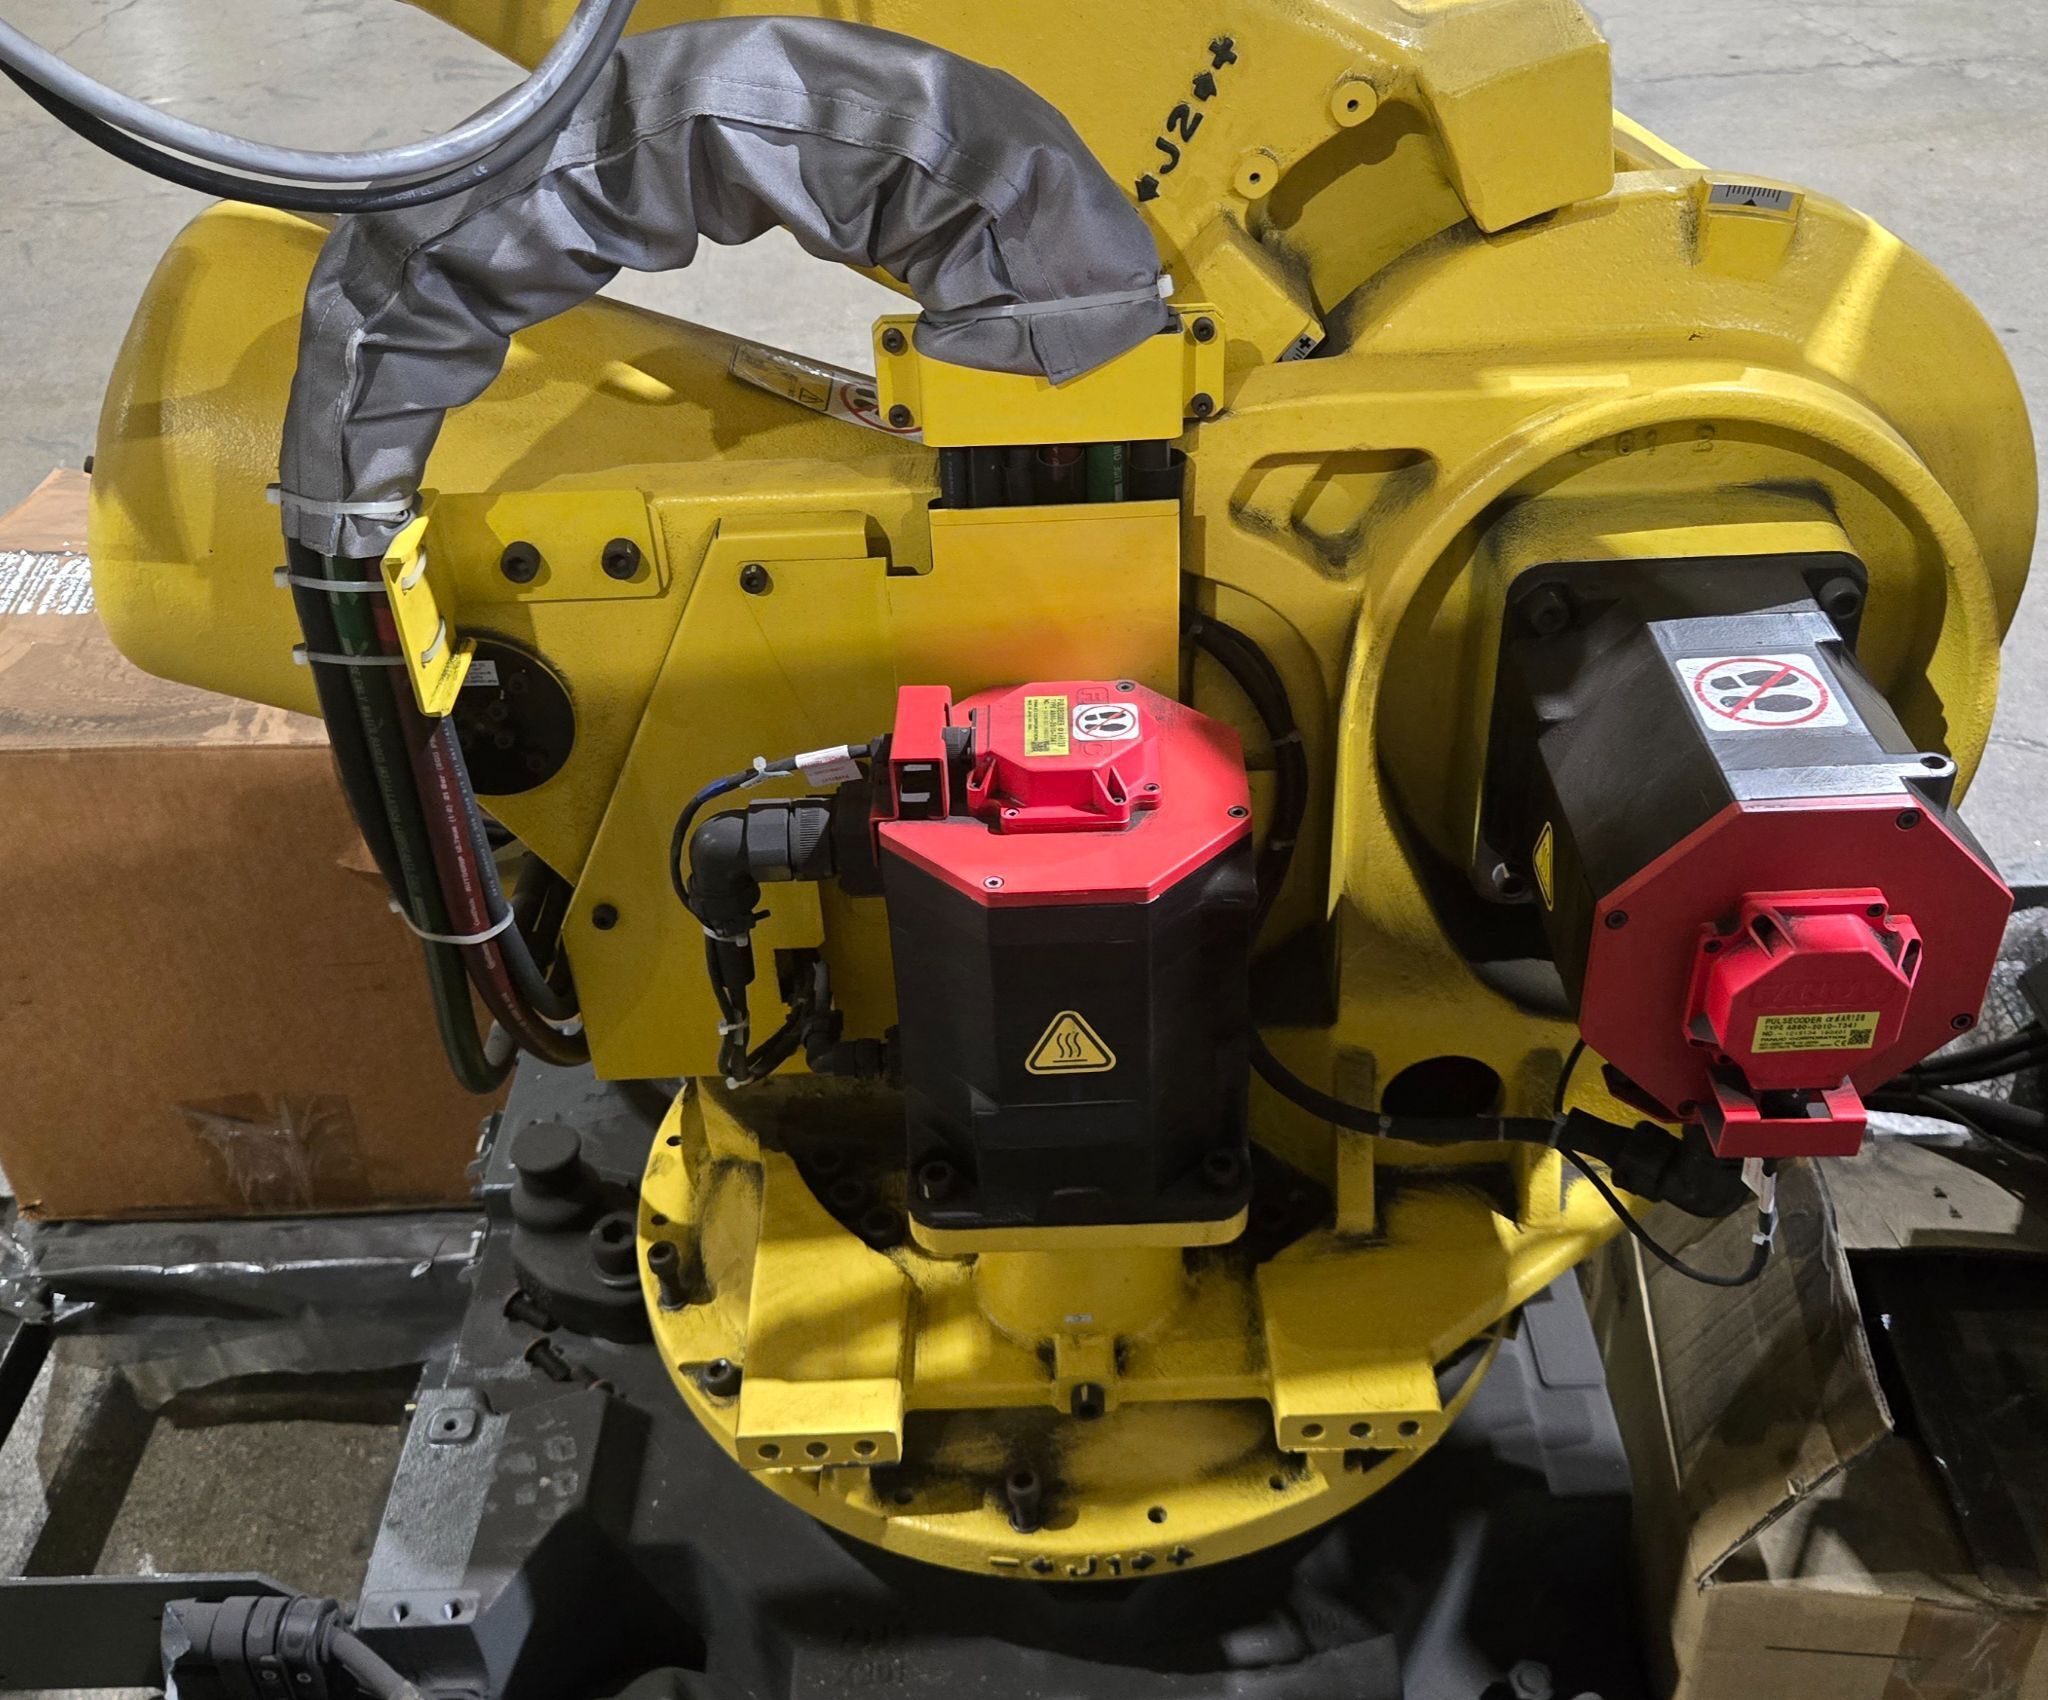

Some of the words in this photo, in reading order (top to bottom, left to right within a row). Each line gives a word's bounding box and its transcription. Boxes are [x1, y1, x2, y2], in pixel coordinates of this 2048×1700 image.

[1155, 103, 1204, 174] J2
[1765, 1016, 1822, 1025] PULSECODER
[1066, 1554, 1122, 1577] J1
